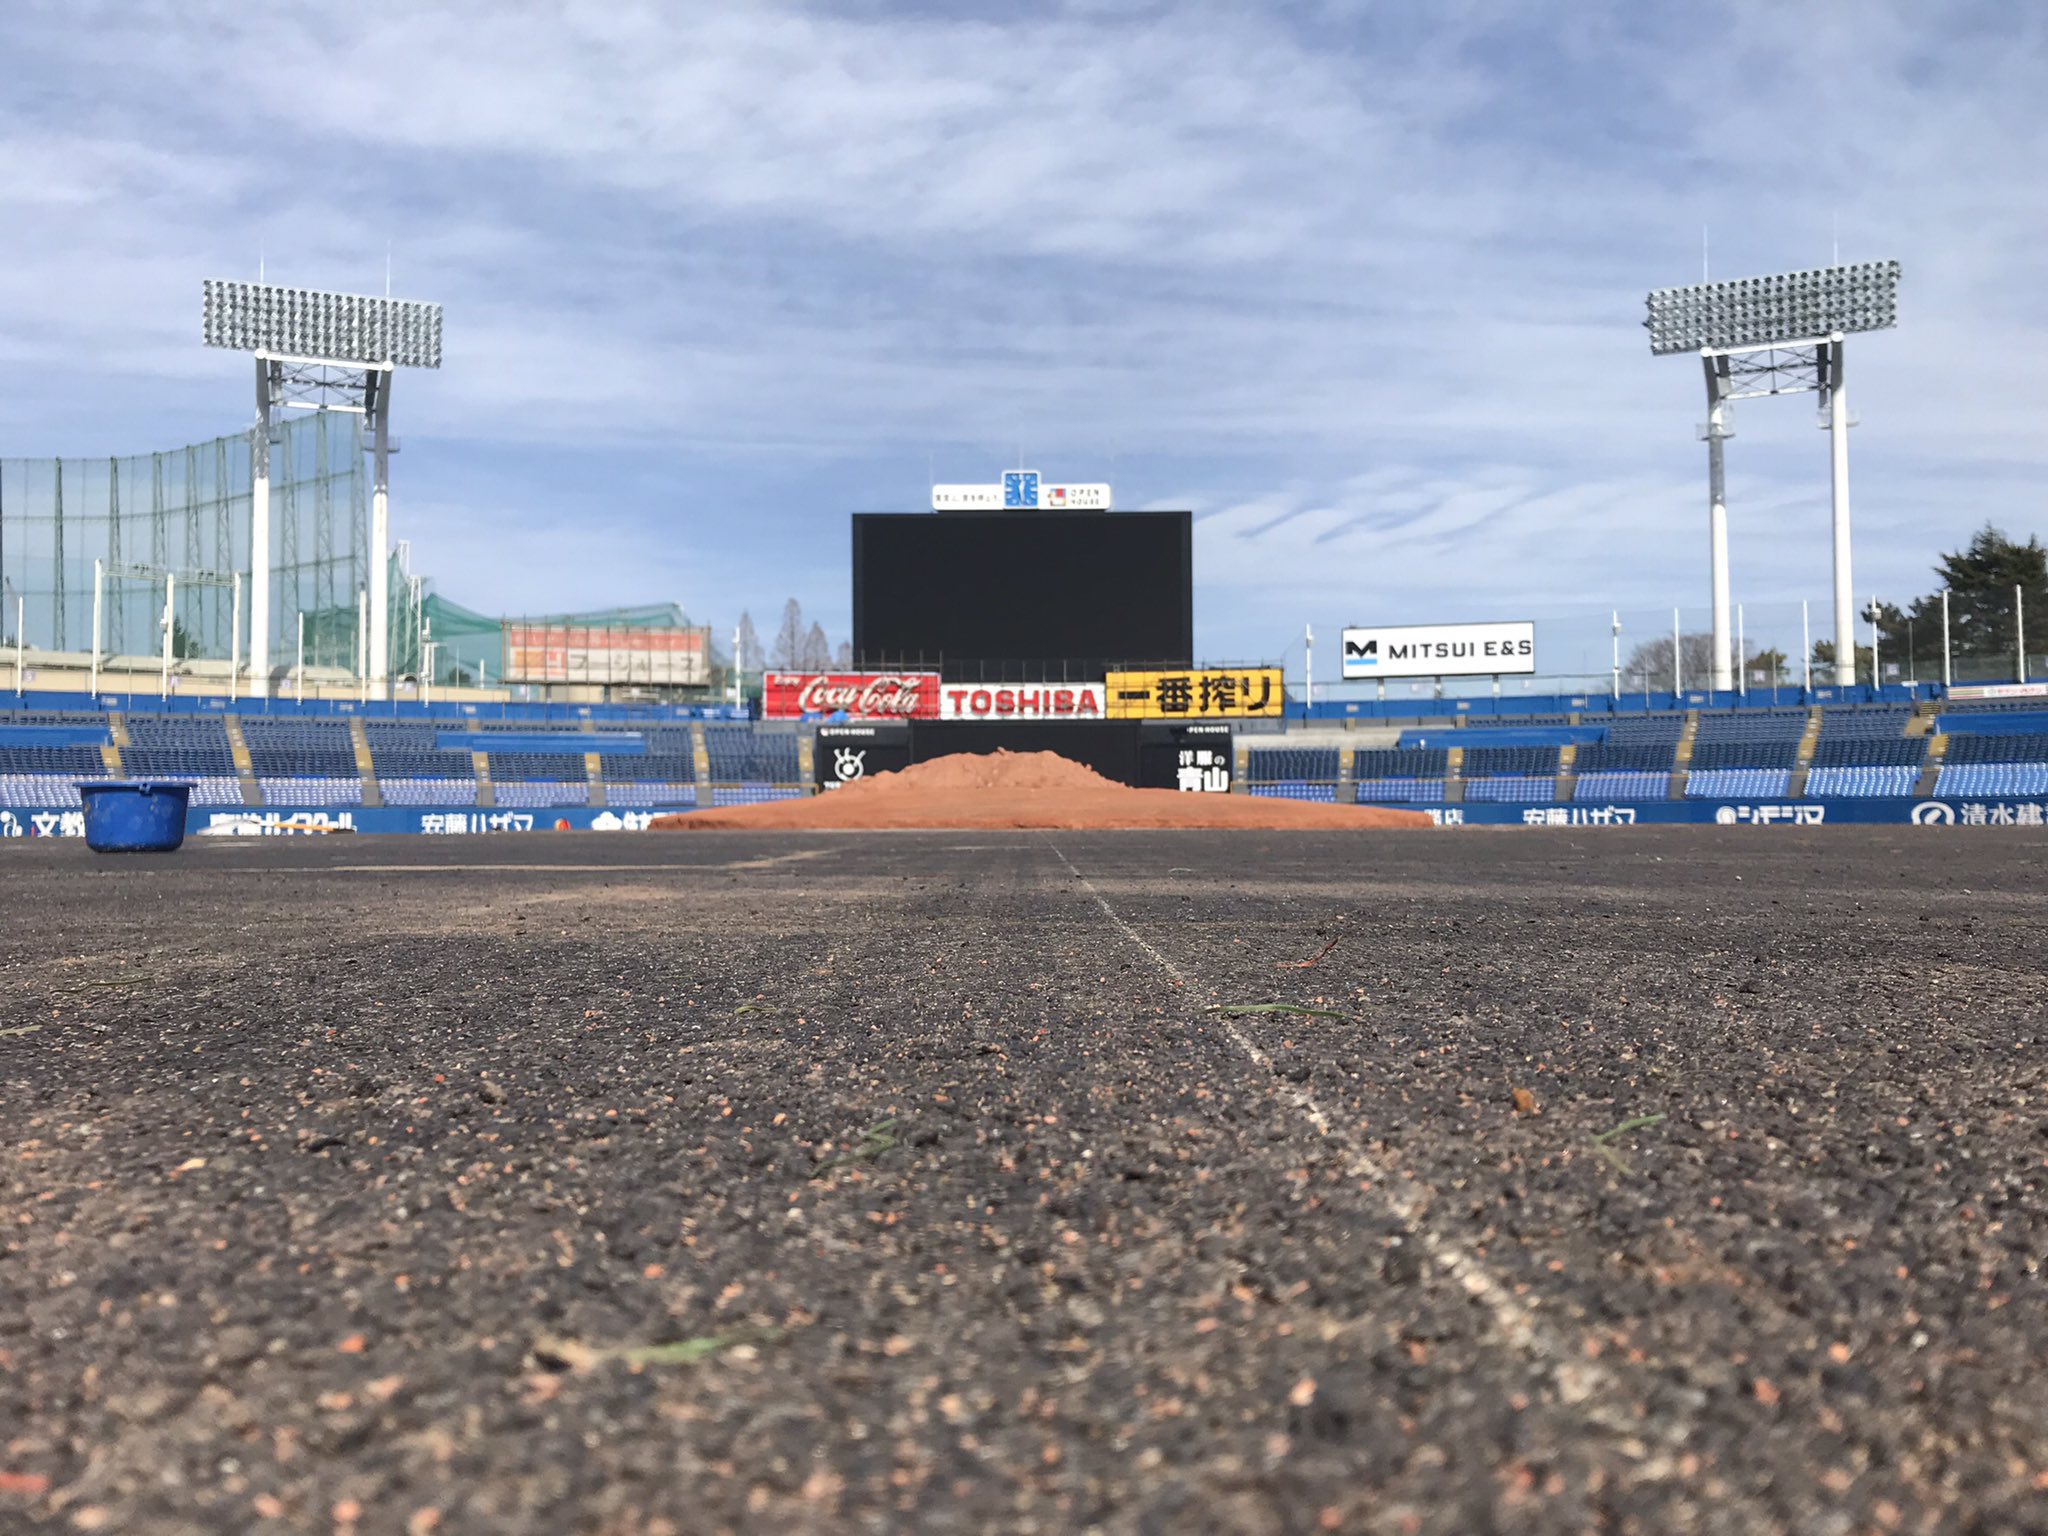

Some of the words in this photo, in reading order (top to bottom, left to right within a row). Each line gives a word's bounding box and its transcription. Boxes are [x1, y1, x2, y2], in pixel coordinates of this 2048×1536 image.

[1388, 642, 1475, 660] MITSUI
[1483, 640, 1532, 657] E&S
[947, 689, 1099, 716] TOSHIBA
[1118, 676, 1271, 714] 一番搾り
[1204, 726, 1229, 734] HOUSE
[1176, 766, 1229, 792] 青山
[421, 811, 534, 834] 安藤ハザマ
[1523, 805, 1636, 825] 安藤ハザマ
[1960, 802, 2048, 825] 清水建
